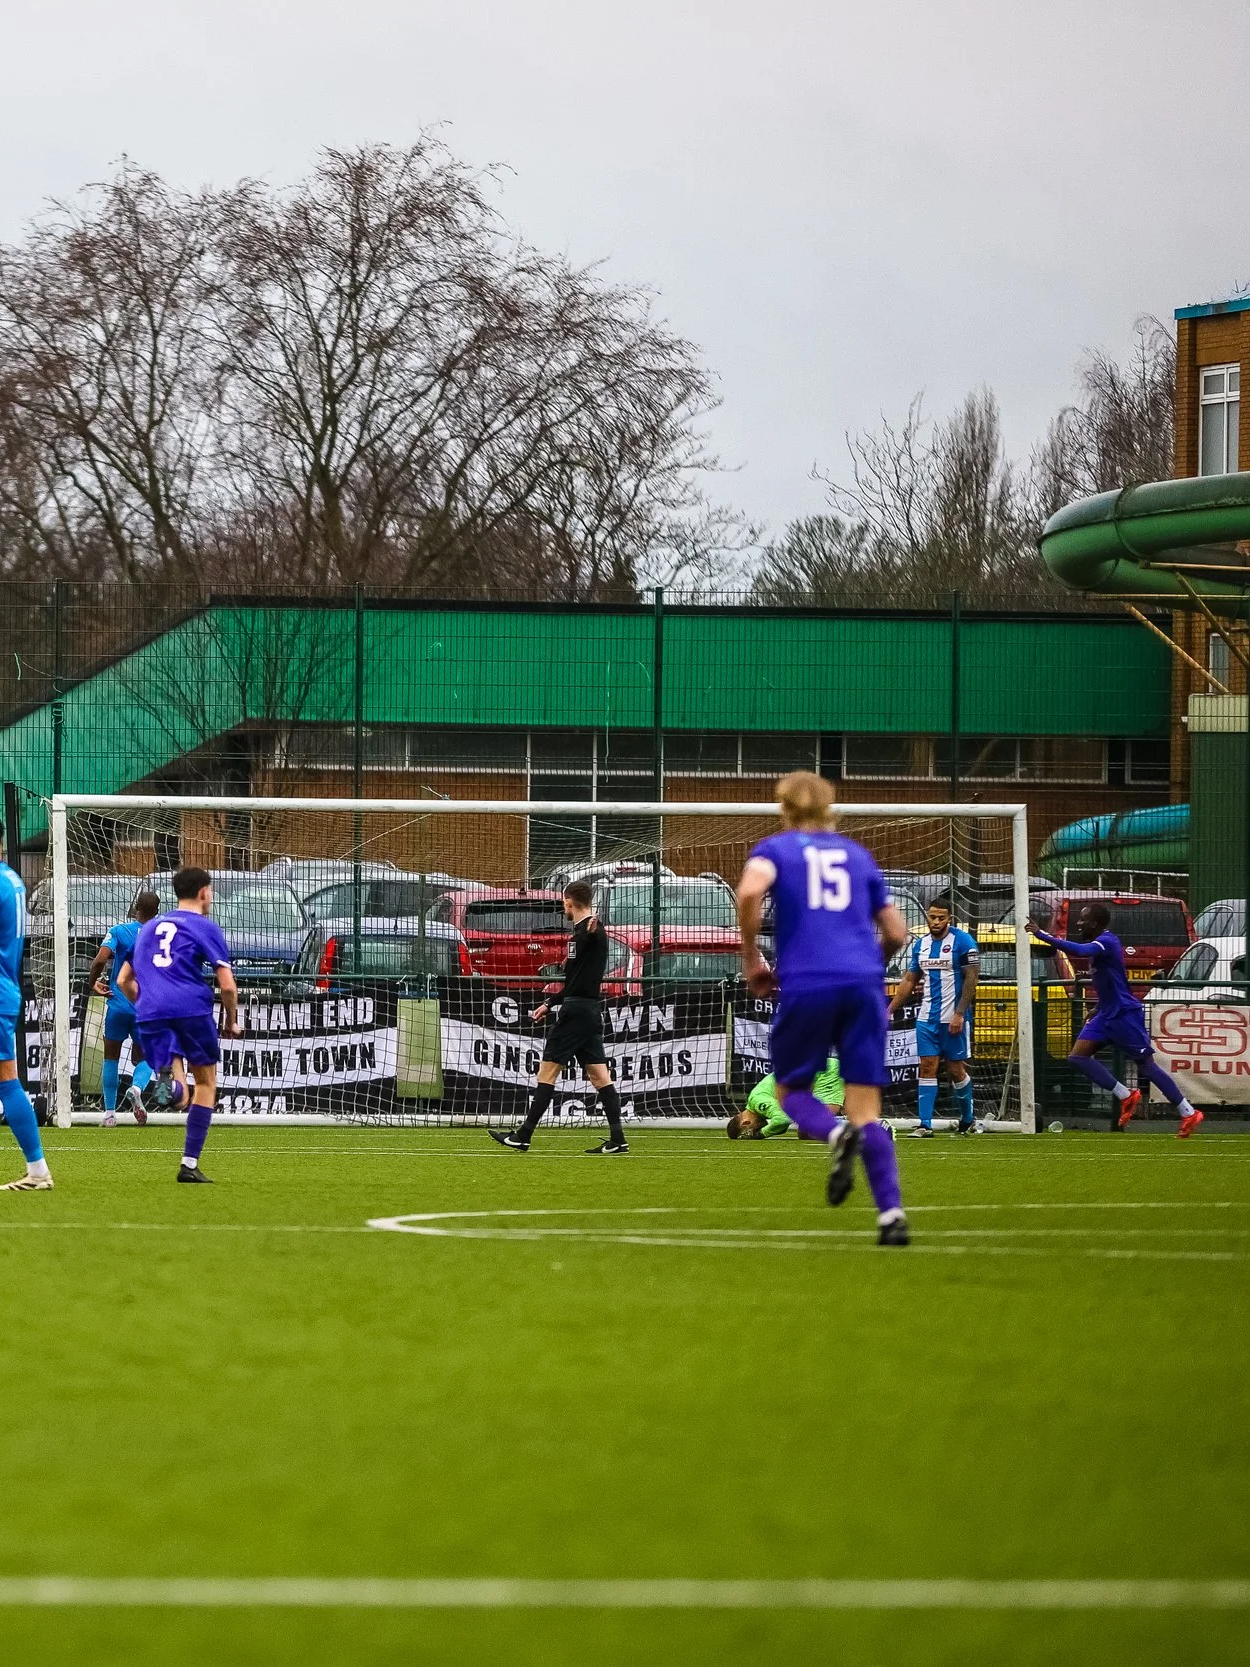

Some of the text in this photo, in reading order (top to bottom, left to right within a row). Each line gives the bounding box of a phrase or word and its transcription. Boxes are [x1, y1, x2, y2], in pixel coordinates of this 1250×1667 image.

[802, 845, 851, 912] 15
[152, 921, 178, 968] 3
[323, 998, 374, 1027] END
[889, 1049, 910, 1057] 1874
[890, 1038, 906, 1047] EST
[295, 1042, 376, 1075] TOWN
